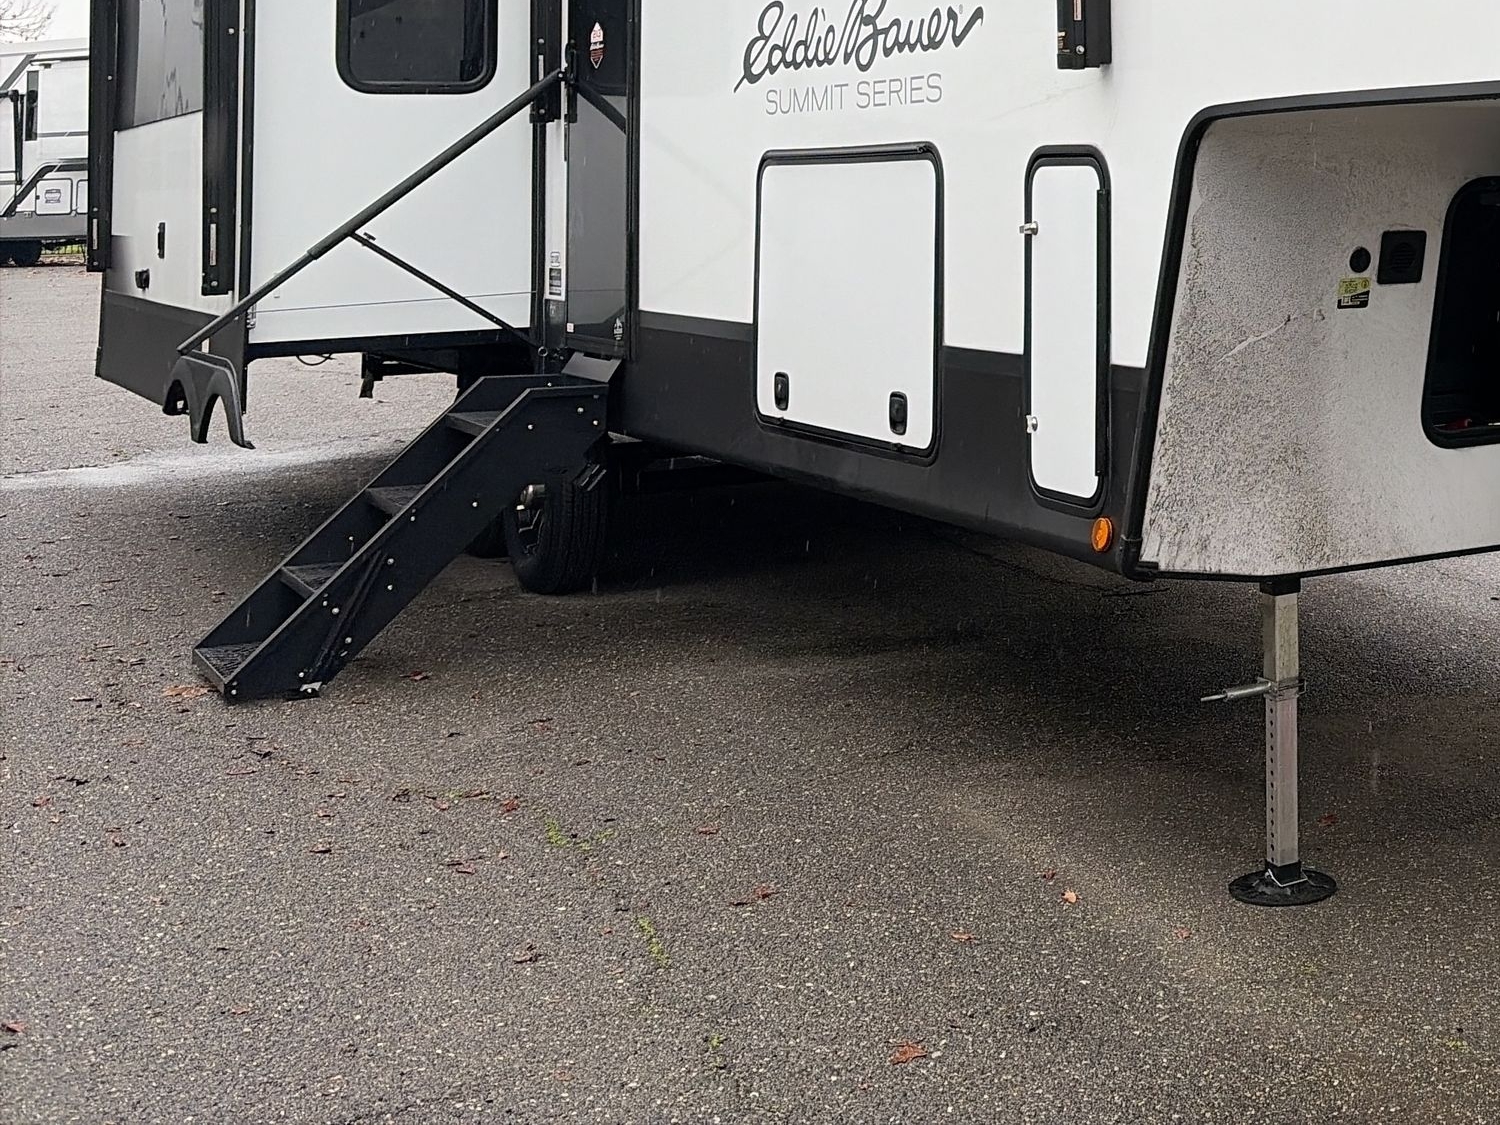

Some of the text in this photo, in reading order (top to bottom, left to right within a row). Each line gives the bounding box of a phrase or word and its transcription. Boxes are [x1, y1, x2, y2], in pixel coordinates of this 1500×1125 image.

[733, 0, 842, 93] Eddie
[765, 72, 943, 115] SUMMIT SERIES
